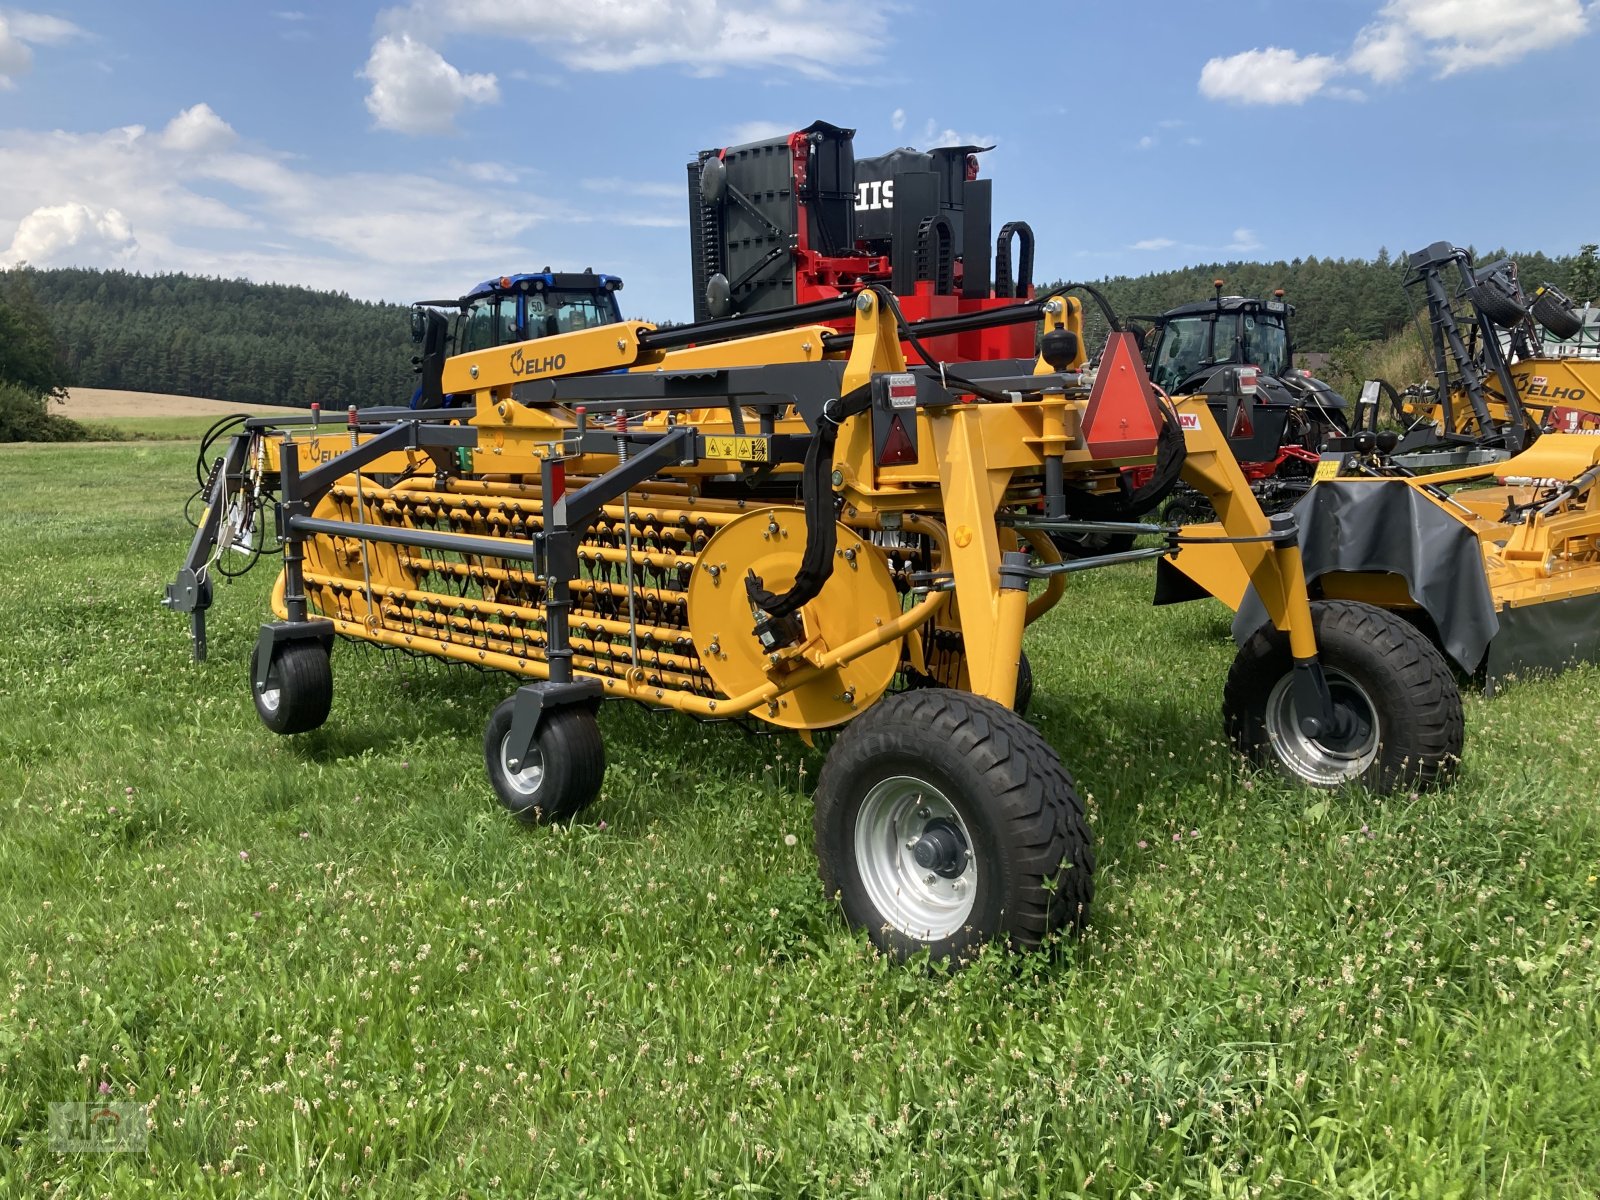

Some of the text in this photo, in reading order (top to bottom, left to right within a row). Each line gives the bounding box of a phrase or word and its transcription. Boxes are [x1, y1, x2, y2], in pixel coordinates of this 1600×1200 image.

[532, 301, 543, 312] 50
[526, 354, 566, 374] ELHO
[1526, 384, 1586, 400] ELHO
